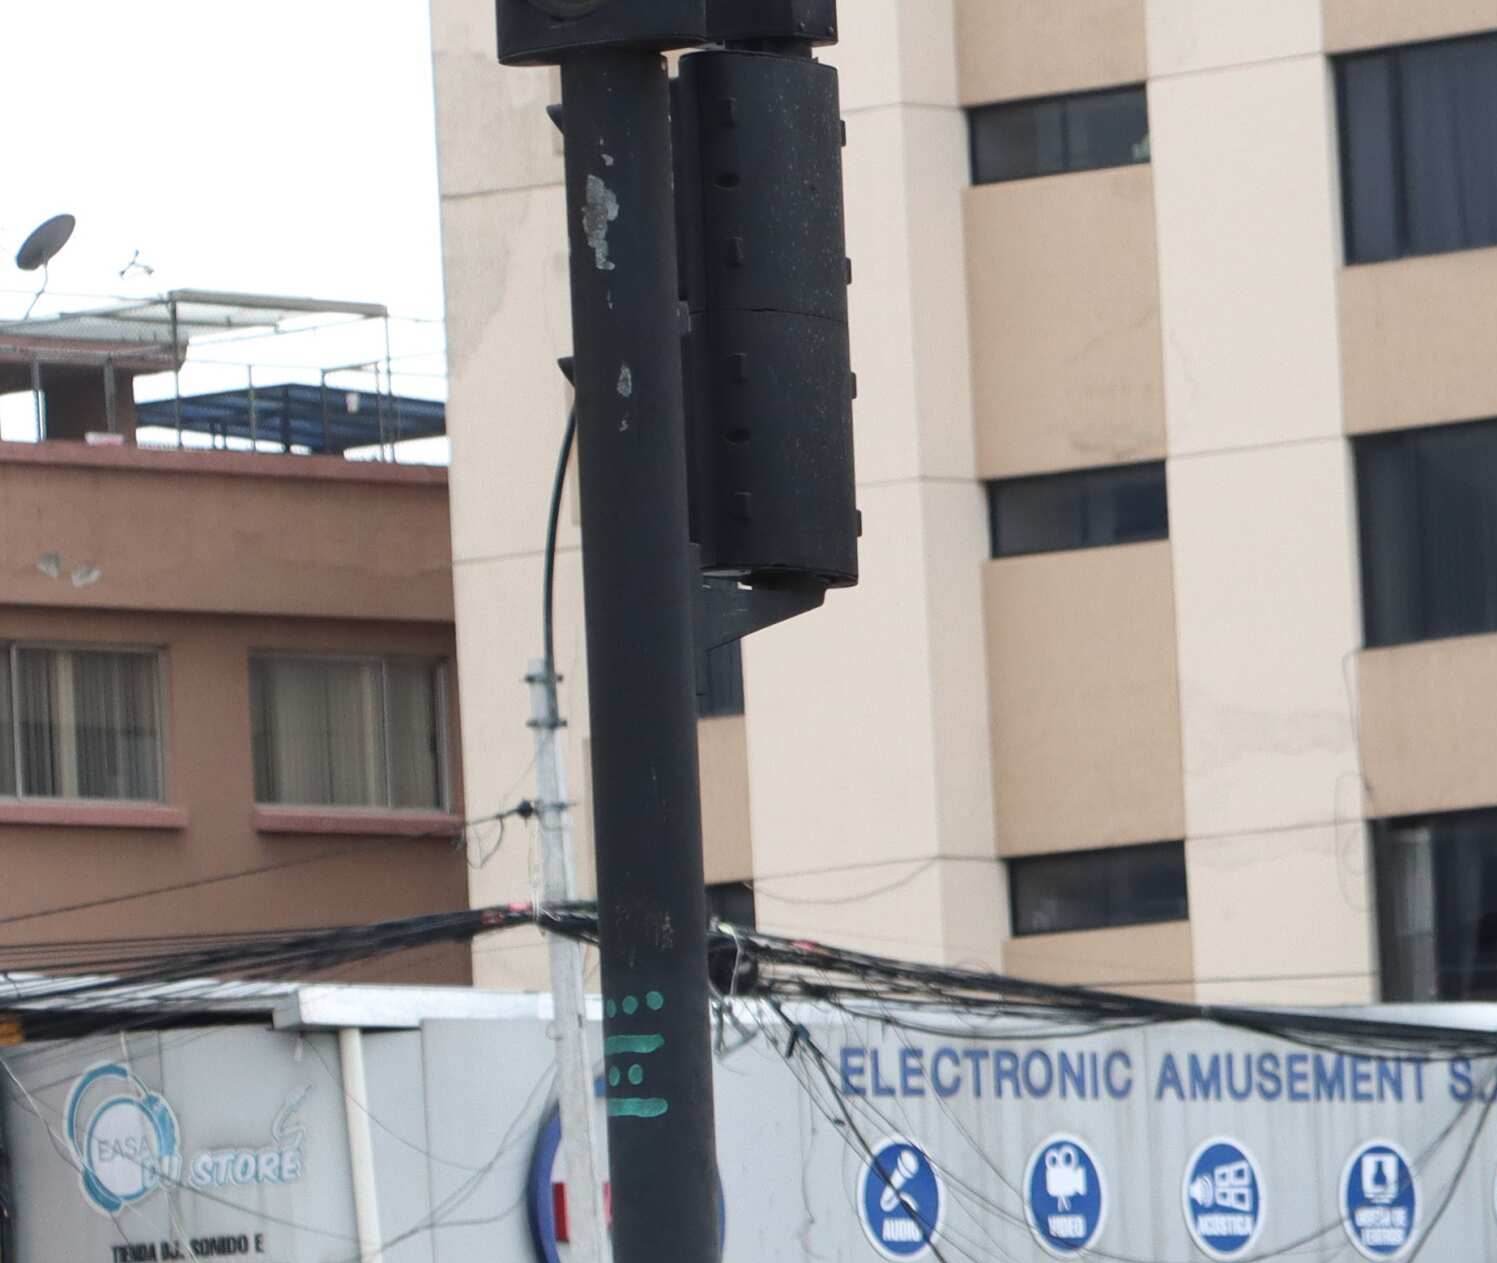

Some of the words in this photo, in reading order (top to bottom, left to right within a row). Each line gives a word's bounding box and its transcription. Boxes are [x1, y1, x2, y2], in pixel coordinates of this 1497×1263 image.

[839, 1046, 1133, 1099] ELECTRONIC
[1155, 1050, 1425, 1101] AMUSEMENT
[190, 1151, 304, 1187] STORE
[190, 1235, 249, 1257] SONIDO
[253, 1233, 264, 1253] E
